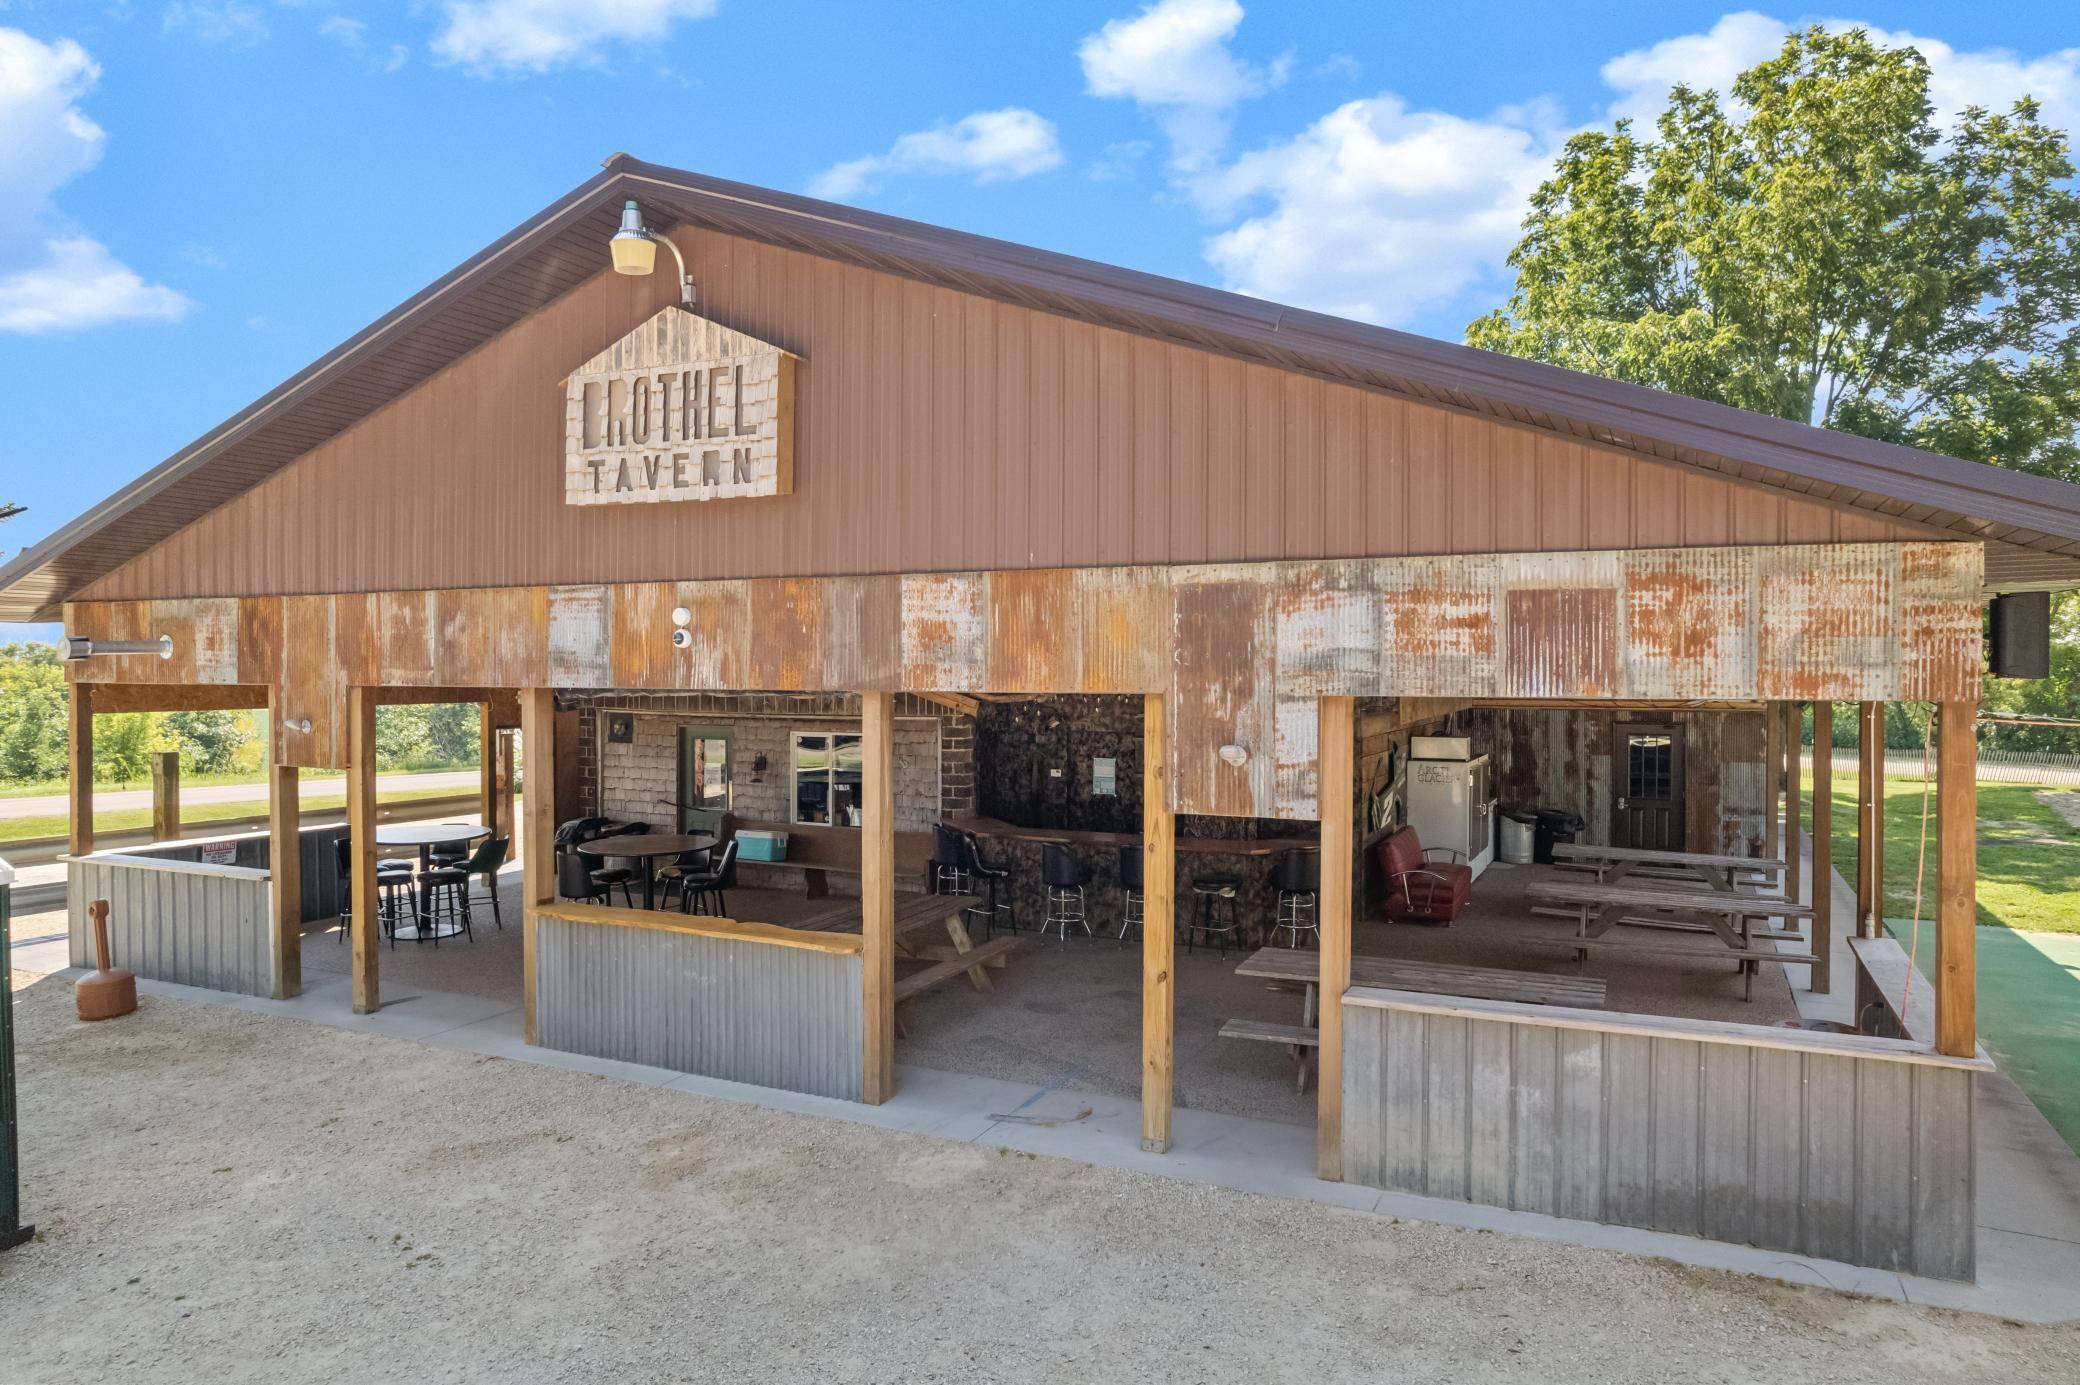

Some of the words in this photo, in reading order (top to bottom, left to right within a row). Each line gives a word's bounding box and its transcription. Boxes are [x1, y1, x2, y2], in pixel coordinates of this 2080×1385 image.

[583, 365, 757, 450] BROTHEL
[588, 447, 752, 494] TAVERN
[1417, 764, 1455, 775] ARCTI
[205, 841, 235, 851] WARNING
